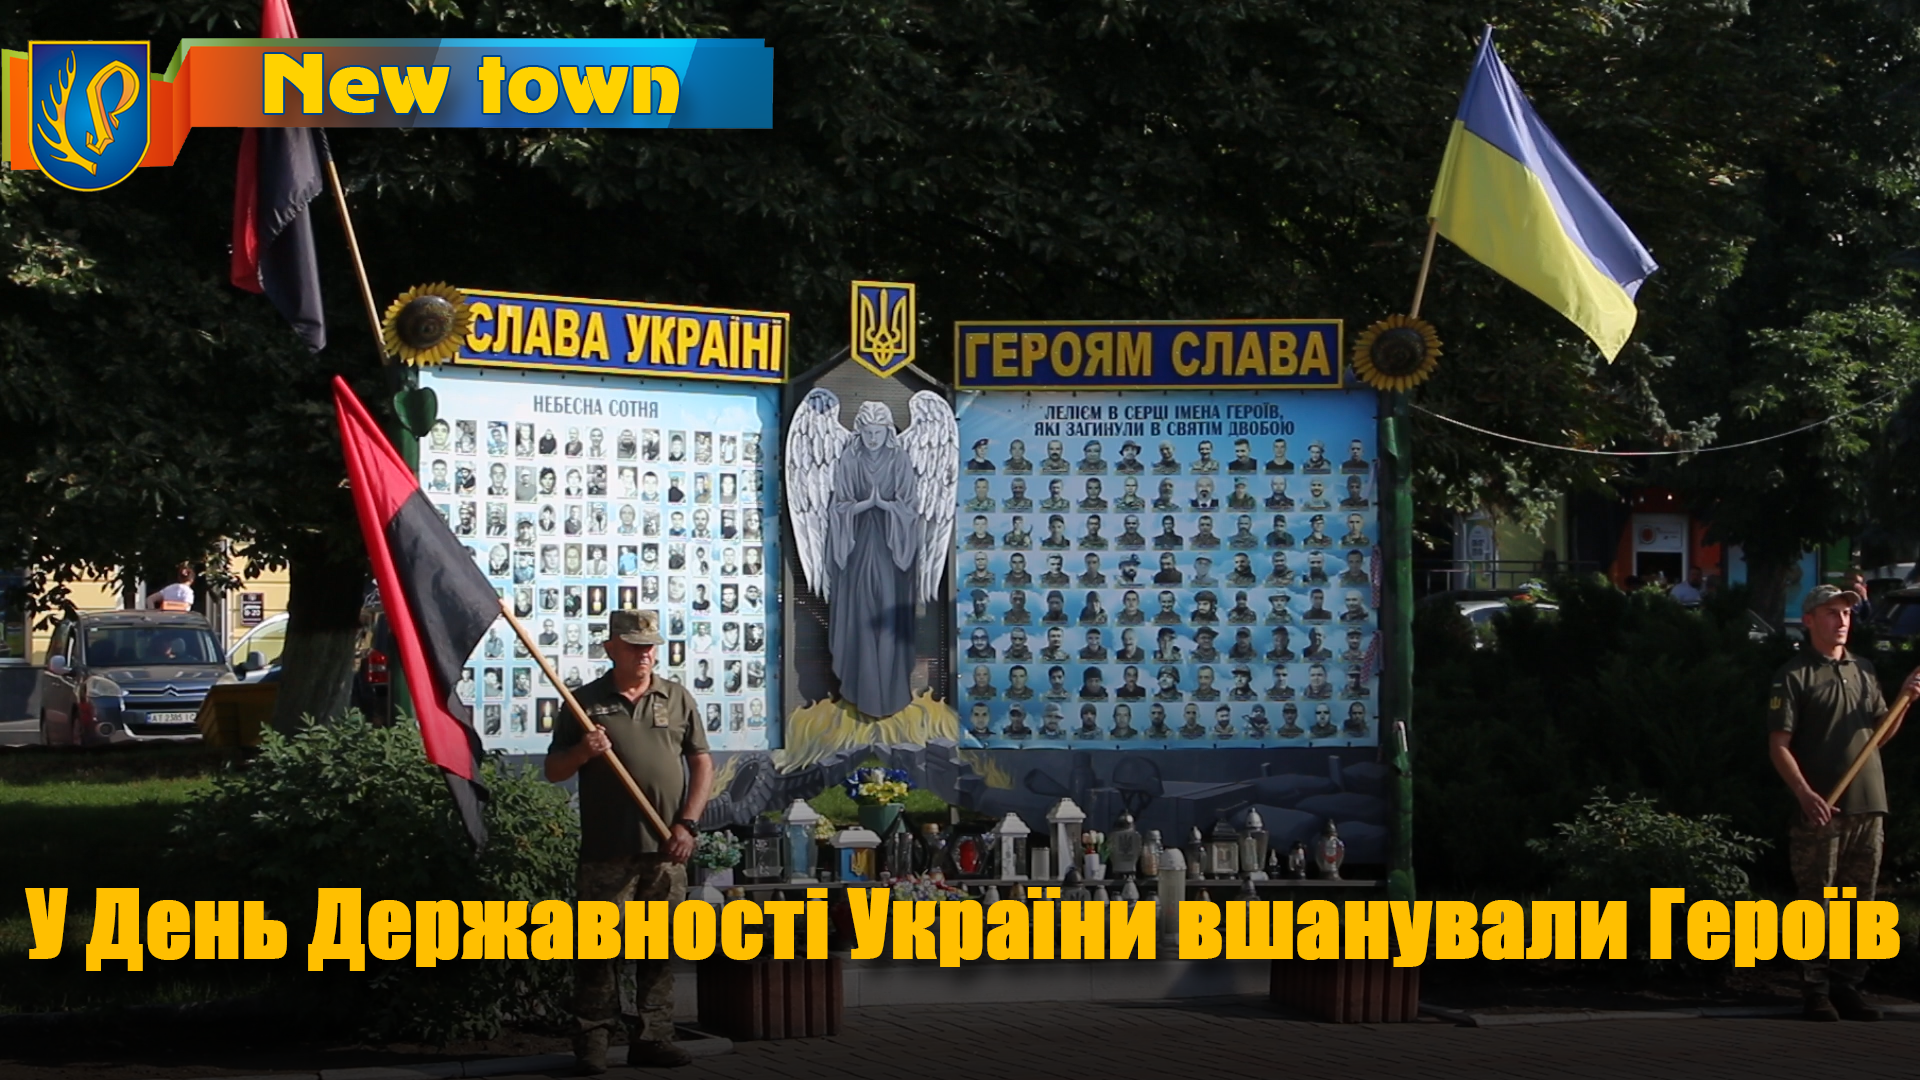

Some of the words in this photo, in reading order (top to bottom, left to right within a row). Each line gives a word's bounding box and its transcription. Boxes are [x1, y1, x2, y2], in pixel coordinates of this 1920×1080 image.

[466, 301, 610, 361] СЛАВА
[625, 313, 783, 372] УКРАЇНІ
[964, 331, 1152, 378] ГЕРОЯМ
[1171, 331, 1331, 376] СЛАВА
[533, 394, 603, 417] НЕБЕСНА
[608, 399, 659, 419] СОТНЯ
[1044, 405, 1101, 420] ЛЕЛІЄМ
[1108, 405, 1118, 420] В
[1124, 405, 1168, 421] СЕРЦІ
[1175, 404, 1220, 420] ІМЕНА
[1226, 402, 1284, 421] ГЕРОЇВ,
[1034, 422, 1060, 436] ЯКІ
[1066, 422, 1143, 436] ЗАГИНУЛИ
[1151, 422, 1161, 436] В
[1167, 422, 1222, 436] СВЯТІМ
[1229, 421, 1294, 437] ДВОБОЮ
